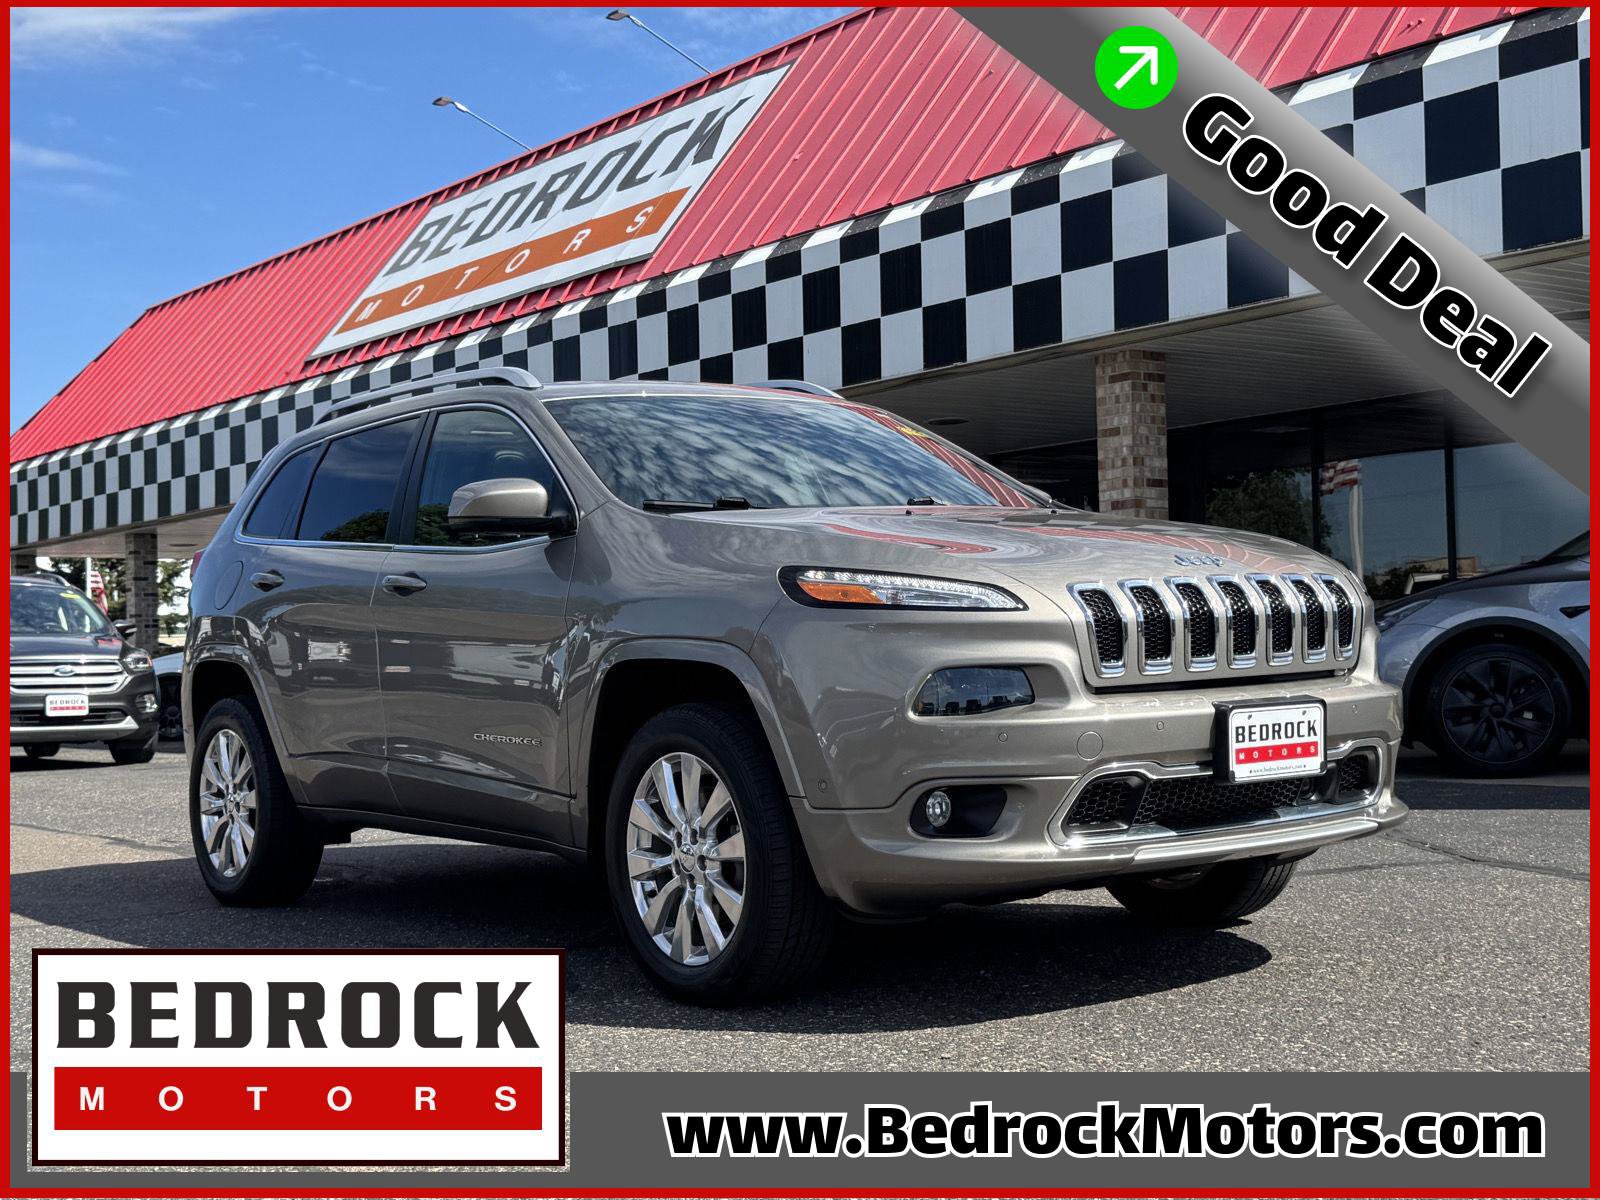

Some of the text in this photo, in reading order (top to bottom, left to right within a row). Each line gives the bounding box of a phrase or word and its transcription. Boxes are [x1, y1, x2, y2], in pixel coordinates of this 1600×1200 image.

[383, 95, 754, 277] BEDROCK
[355, 205, 654, 323] MOTORS
[473, 733, 541, 746] CHEROKEE
[1235, 720, 1318, 743] BEDROCK
[1239, 745, 1316, 760] MOTORS
